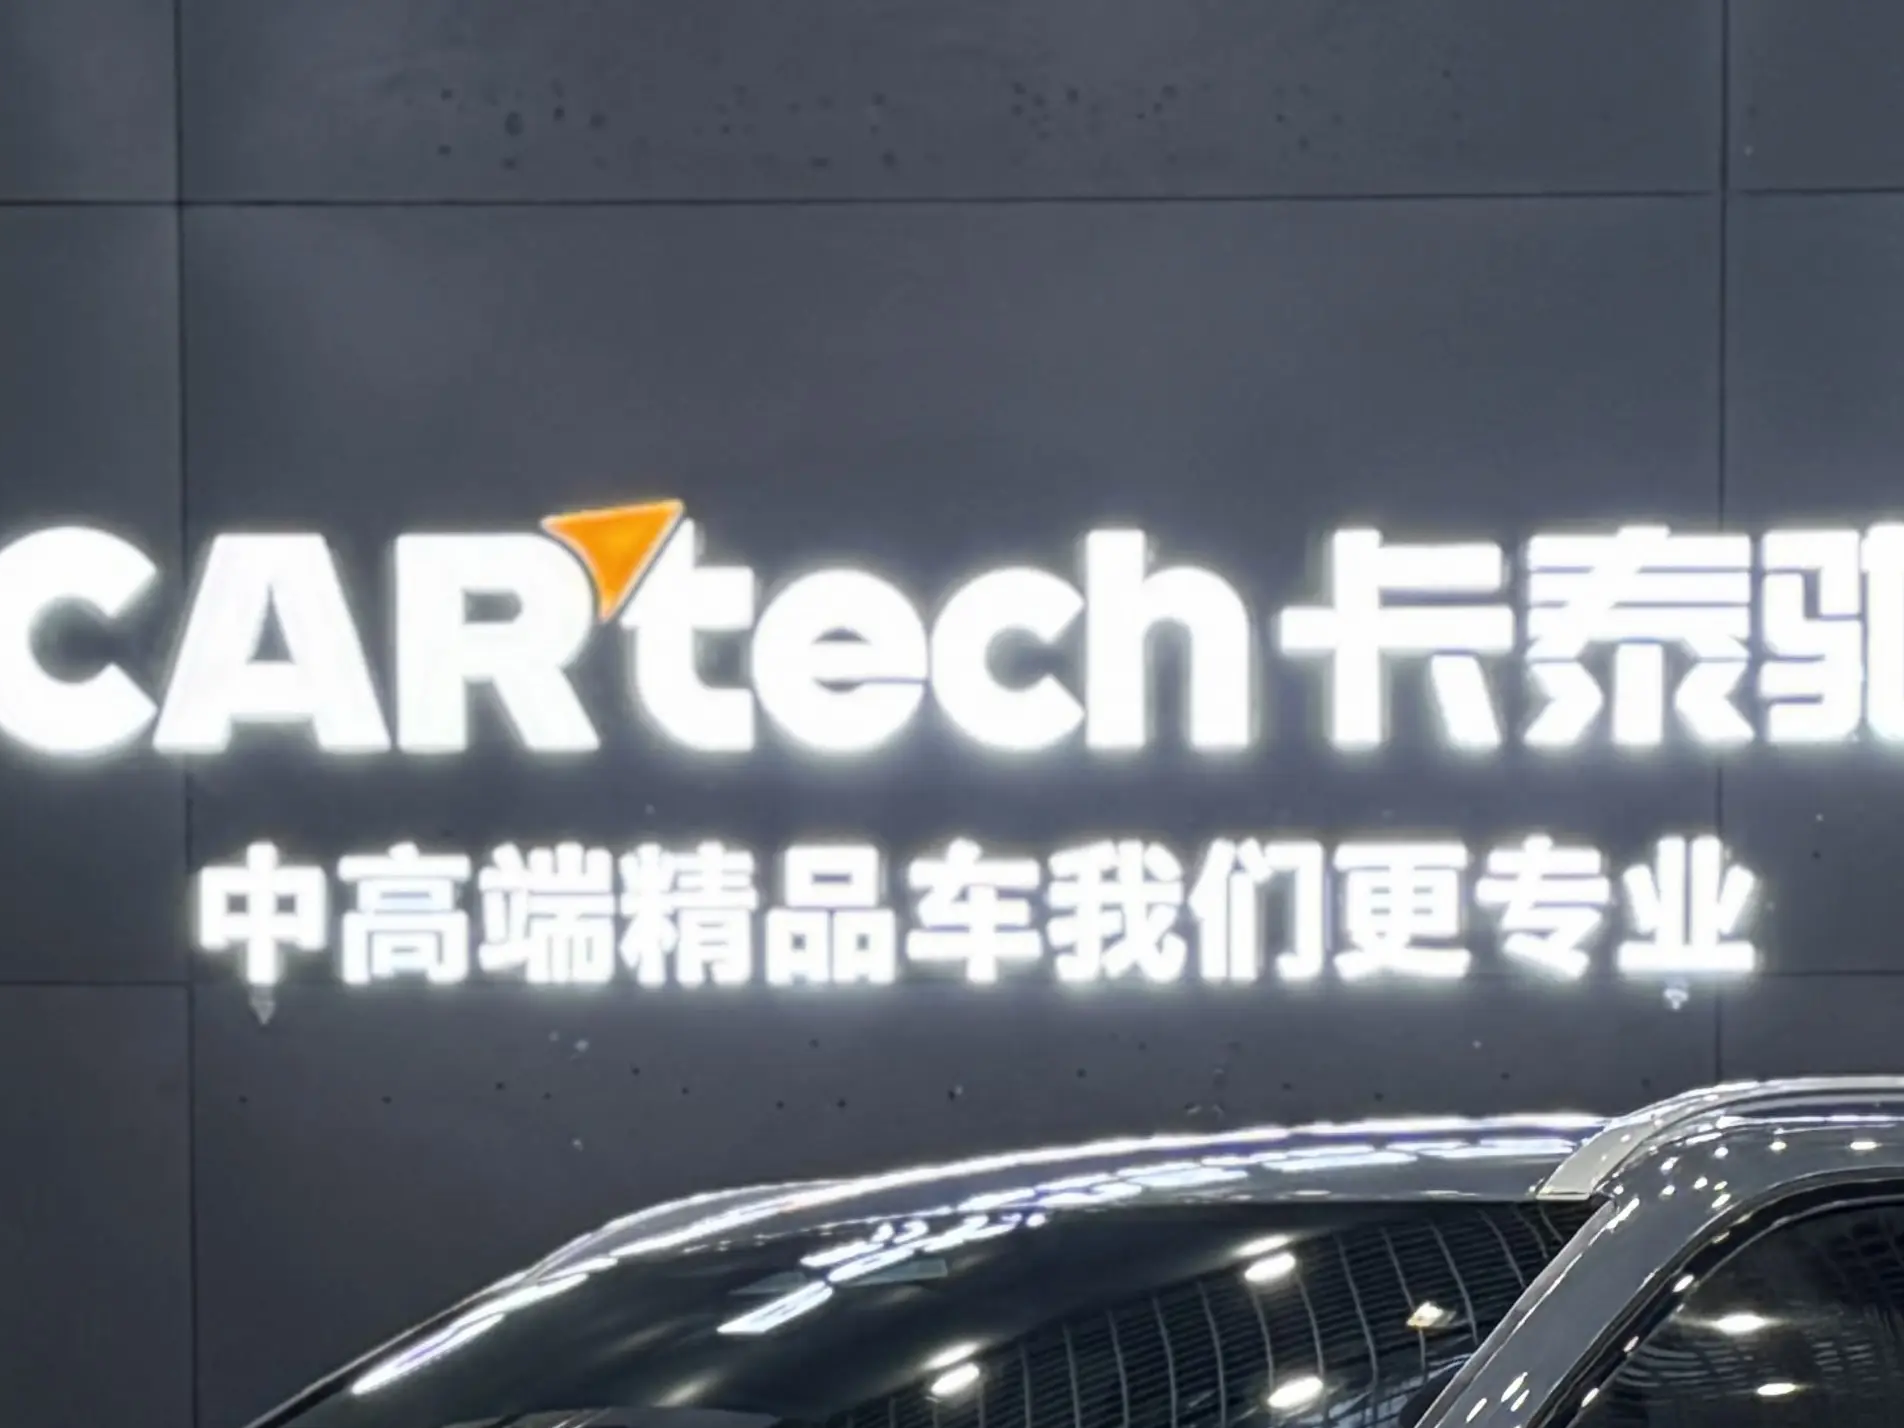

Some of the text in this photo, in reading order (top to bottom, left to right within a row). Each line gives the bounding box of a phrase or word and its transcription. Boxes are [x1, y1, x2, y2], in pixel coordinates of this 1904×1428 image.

[200, 836, 1754, 985] 中高端精品车我们更专业
